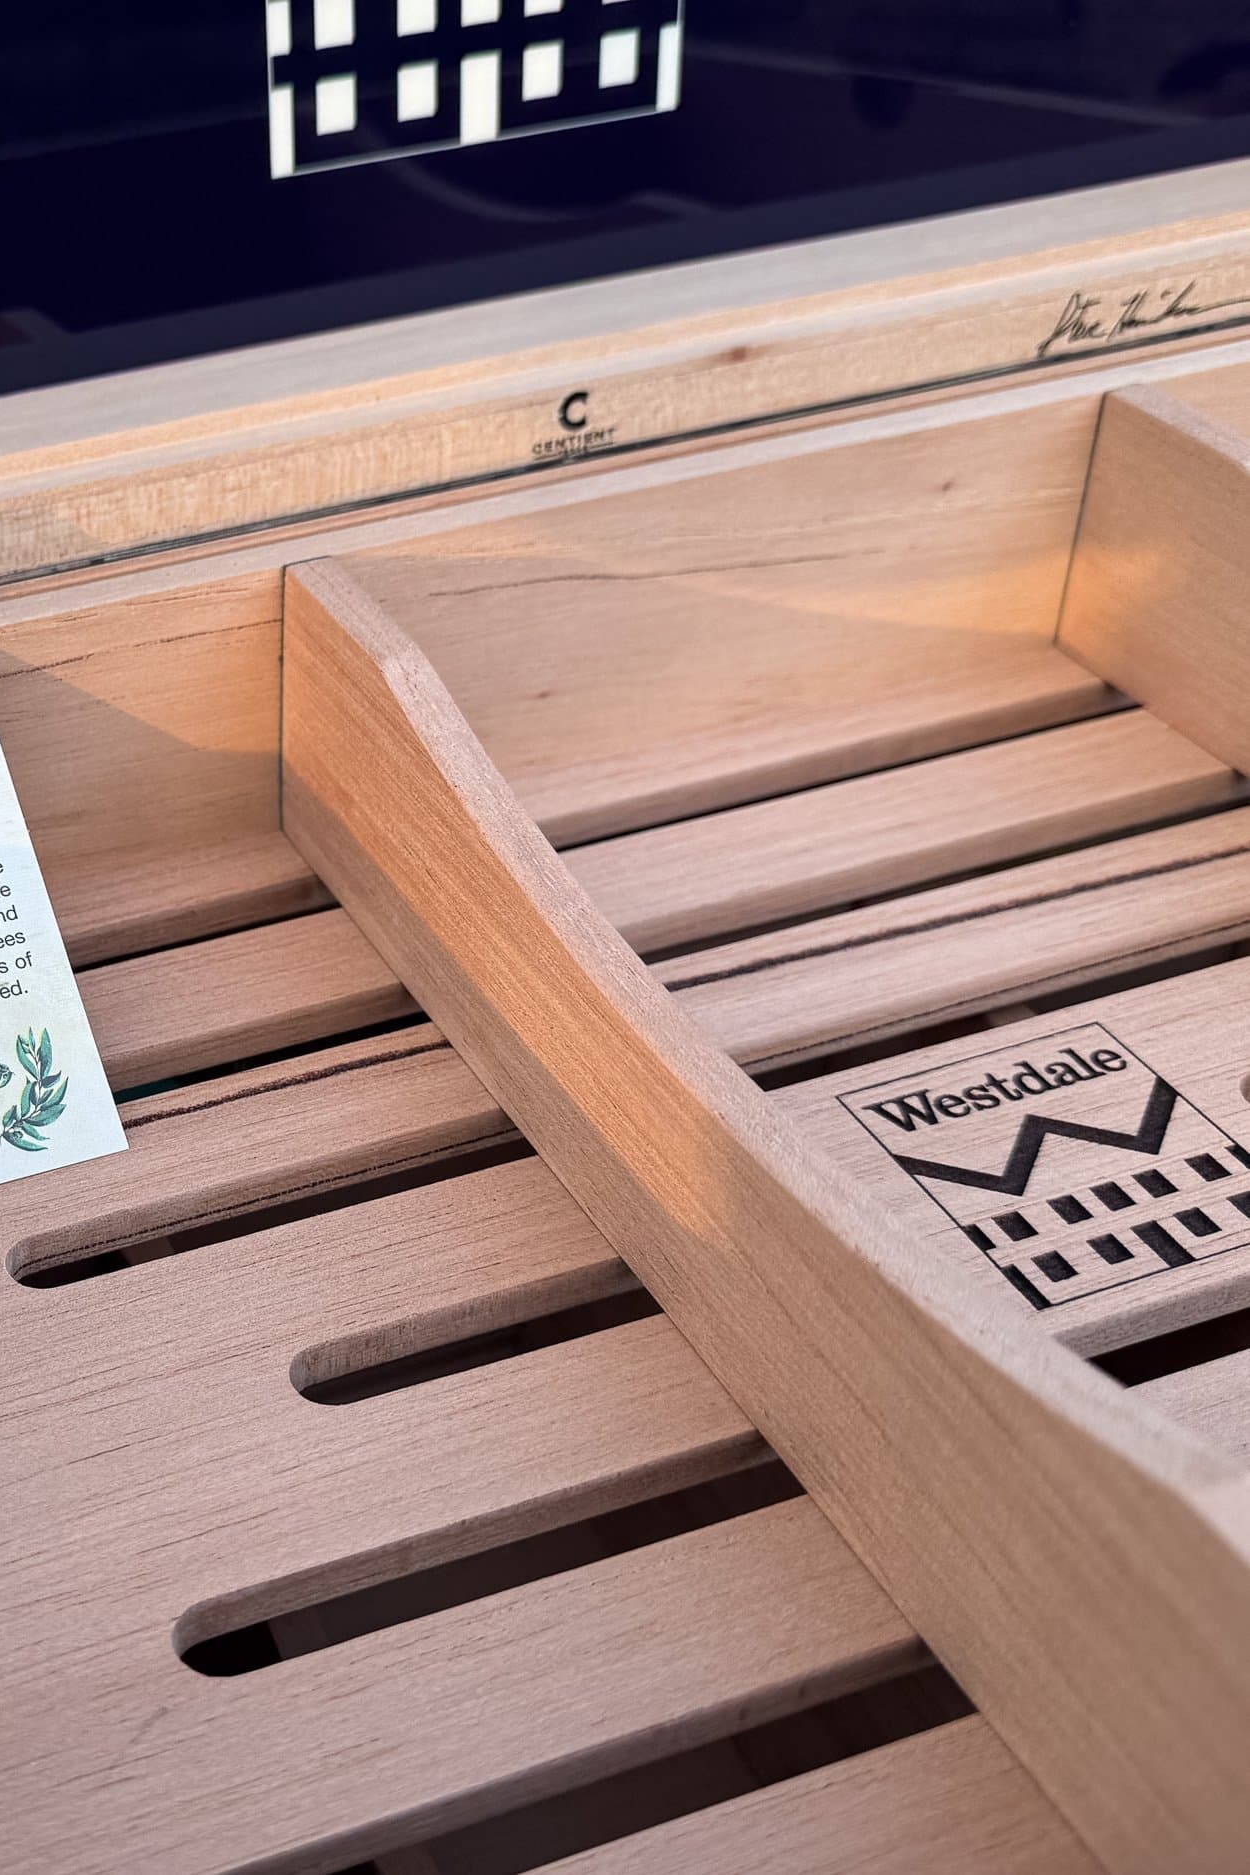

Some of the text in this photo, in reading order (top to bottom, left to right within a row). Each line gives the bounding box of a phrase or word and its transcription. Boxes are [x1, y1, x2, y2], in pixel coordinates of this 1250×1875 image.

[558, 391, 589, 431] C
[14, 950, 33, 970] of
[862, 1047, 1128, 1132] Westdale
